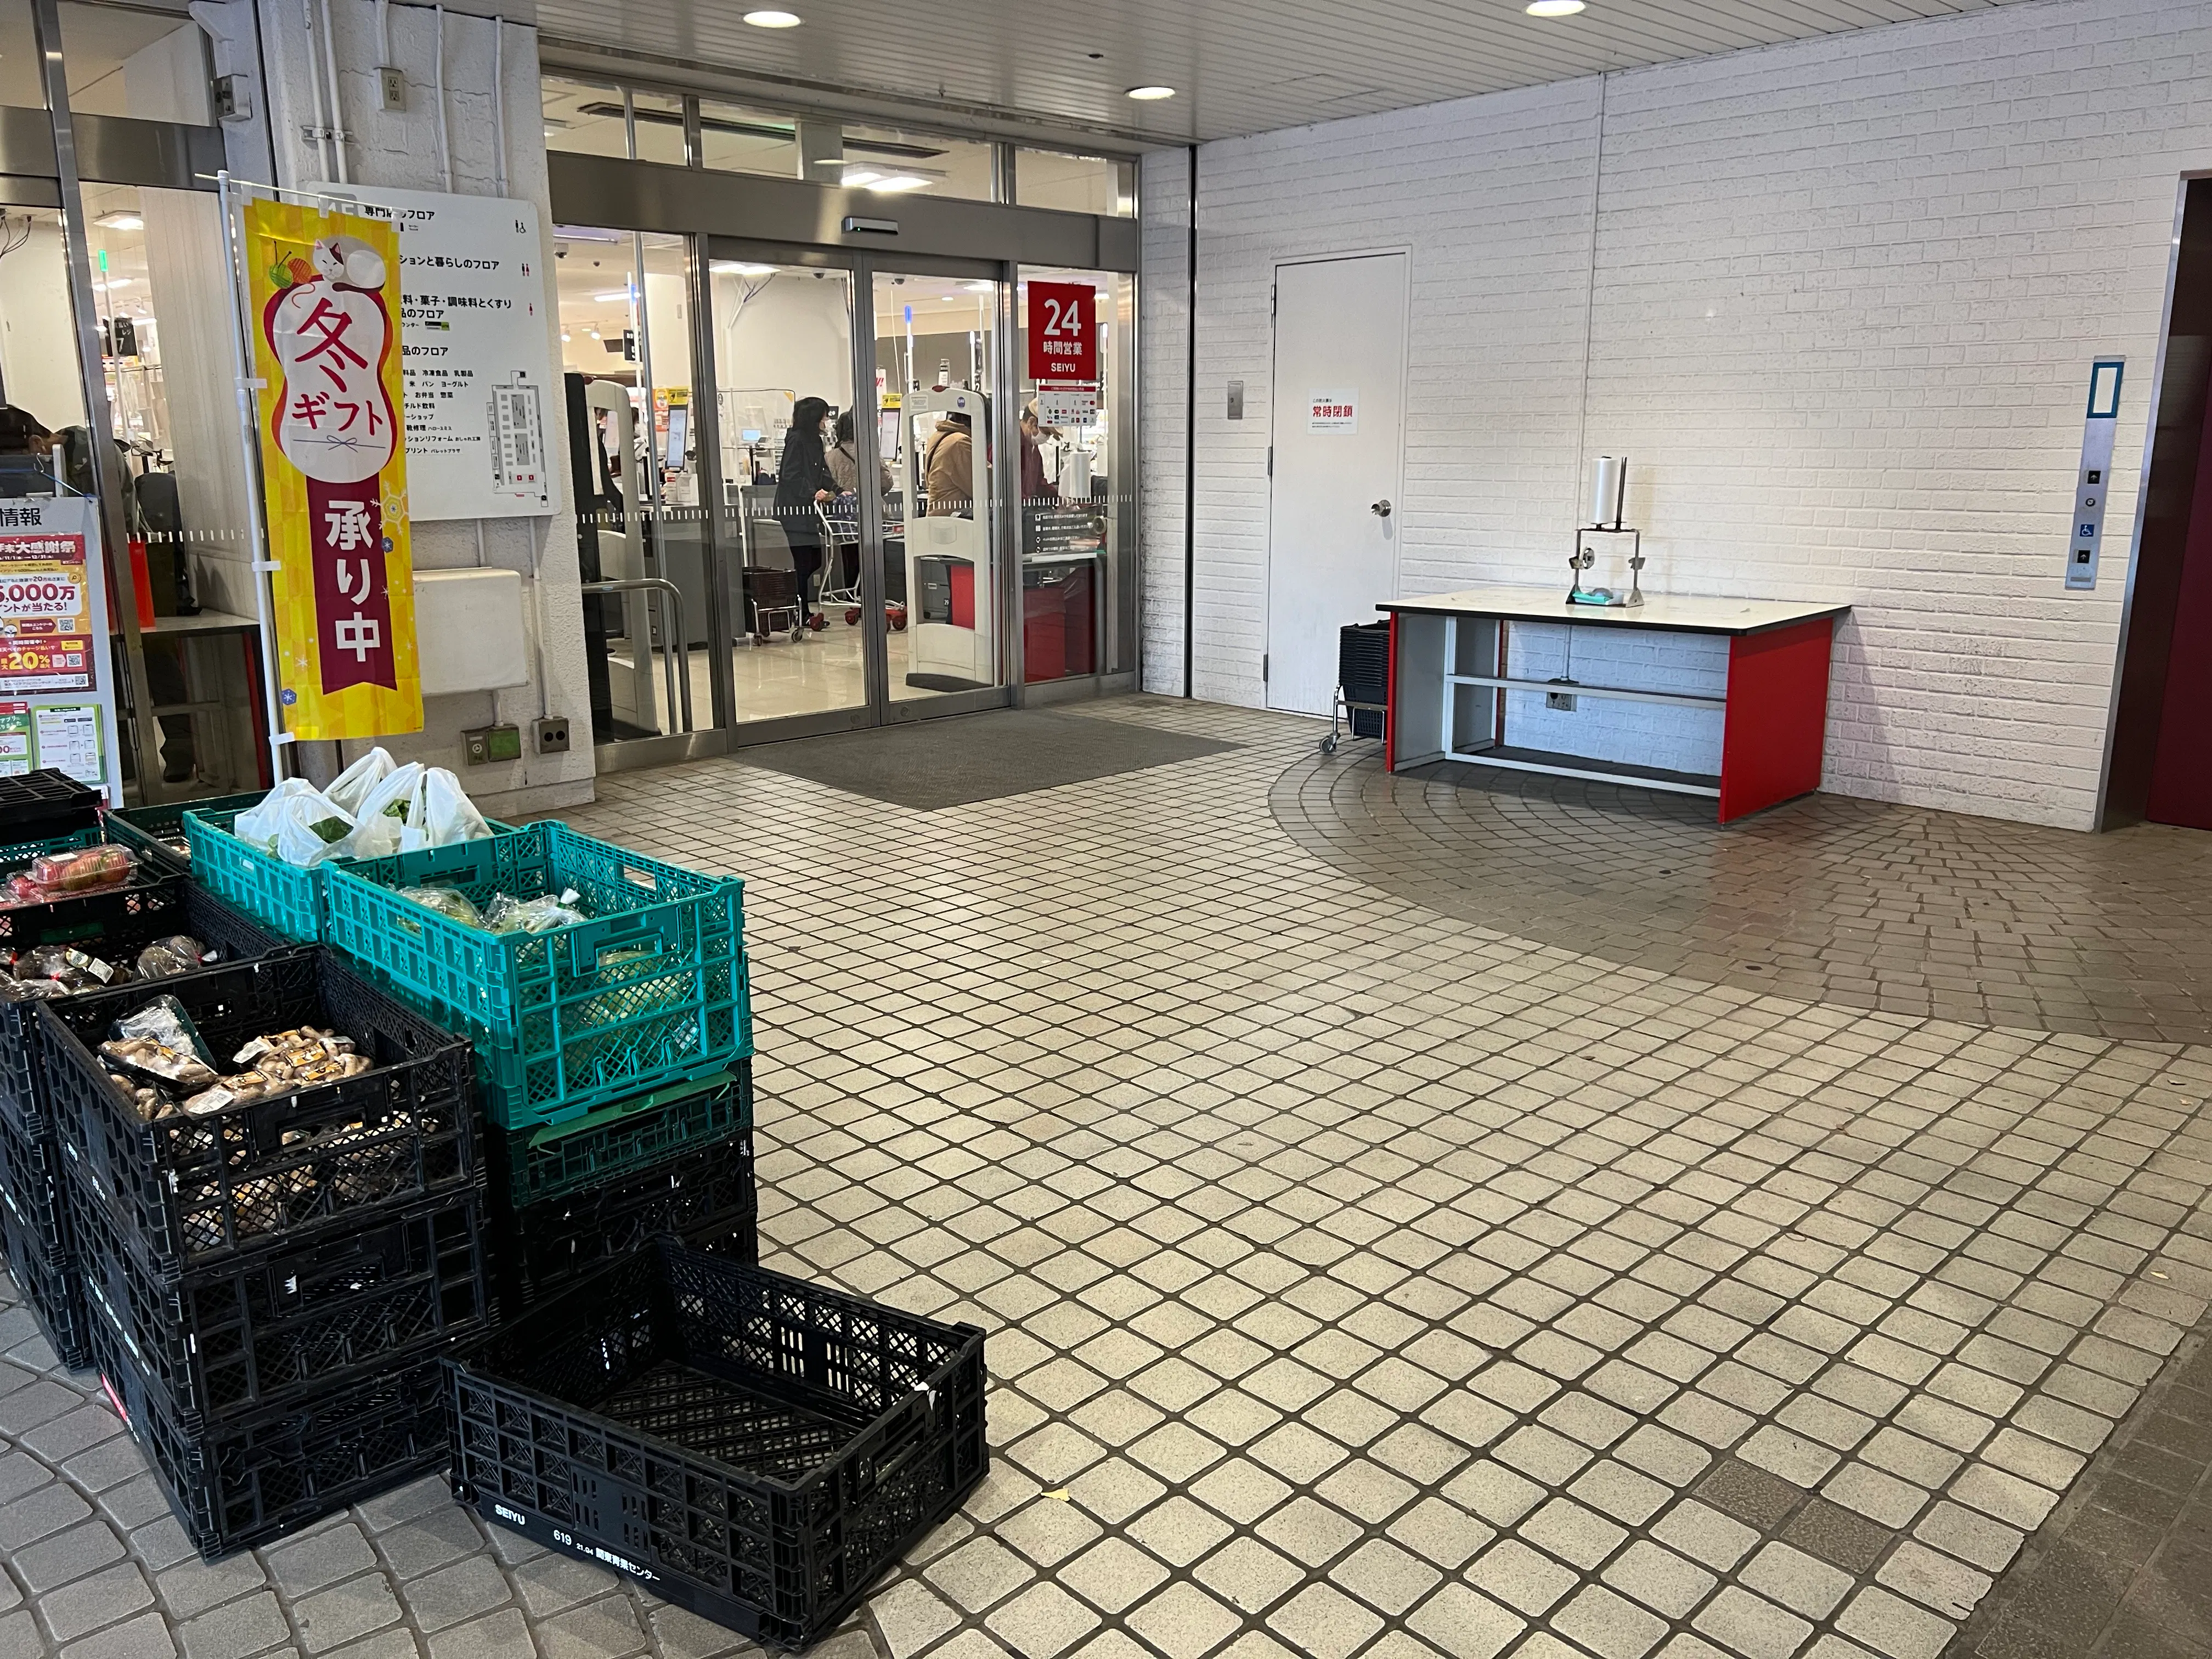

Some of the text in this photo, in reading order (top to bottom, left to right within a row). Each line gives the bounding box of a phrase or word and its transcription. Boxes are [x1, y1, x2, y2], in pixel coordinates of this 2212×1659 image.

[401, 295, 511, 308] 料・菓子・調味料とくすり
[1043, 298, 1082, 337] 24
[294, 297, 368, 393] 冬
[1043, 341, 1082, 356] 時間営業
[1051, 362, 1076, 373] SEIYU
[292, 392, 385, 436] ギフト
[1313, 405, 1353, 417] 常時閉鎖
[0, 507, 42, 527] 情報
[324, 499, 381, 662] 承り中
[8, 651, 50, 670] 20%
[494, 1504, 526, 1526] SEIYU
[554, 1530, 572, 1546] 619
[596, 1548, 660, 1581] 関東青果センター
